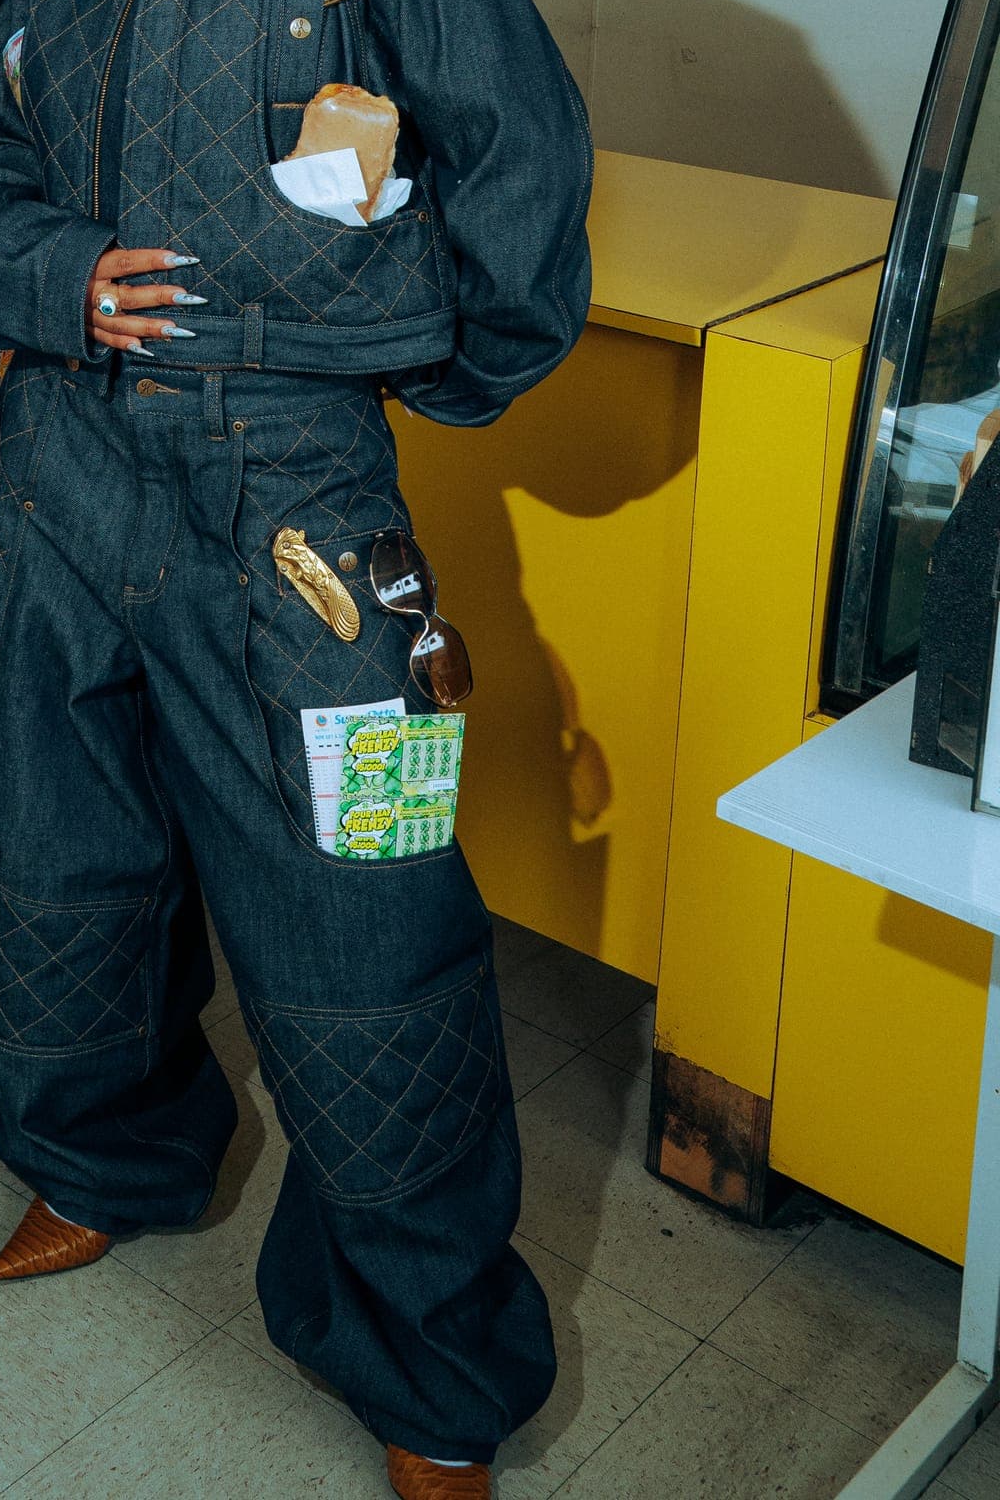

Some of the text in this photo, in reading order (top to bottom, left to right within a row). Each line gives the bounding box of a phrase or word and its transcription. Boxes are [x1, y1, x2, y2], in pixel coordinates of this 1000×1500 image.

[356, 731, 379, 743] FOUR
[379, 728, 399, 739] LEAF
[351, 738, 399, 756] FRENZY
[349, 809, 372, 820] FOUR
[373, 807, 393, 818] LEAF
[344, 817, 394, 833] FRENZY
